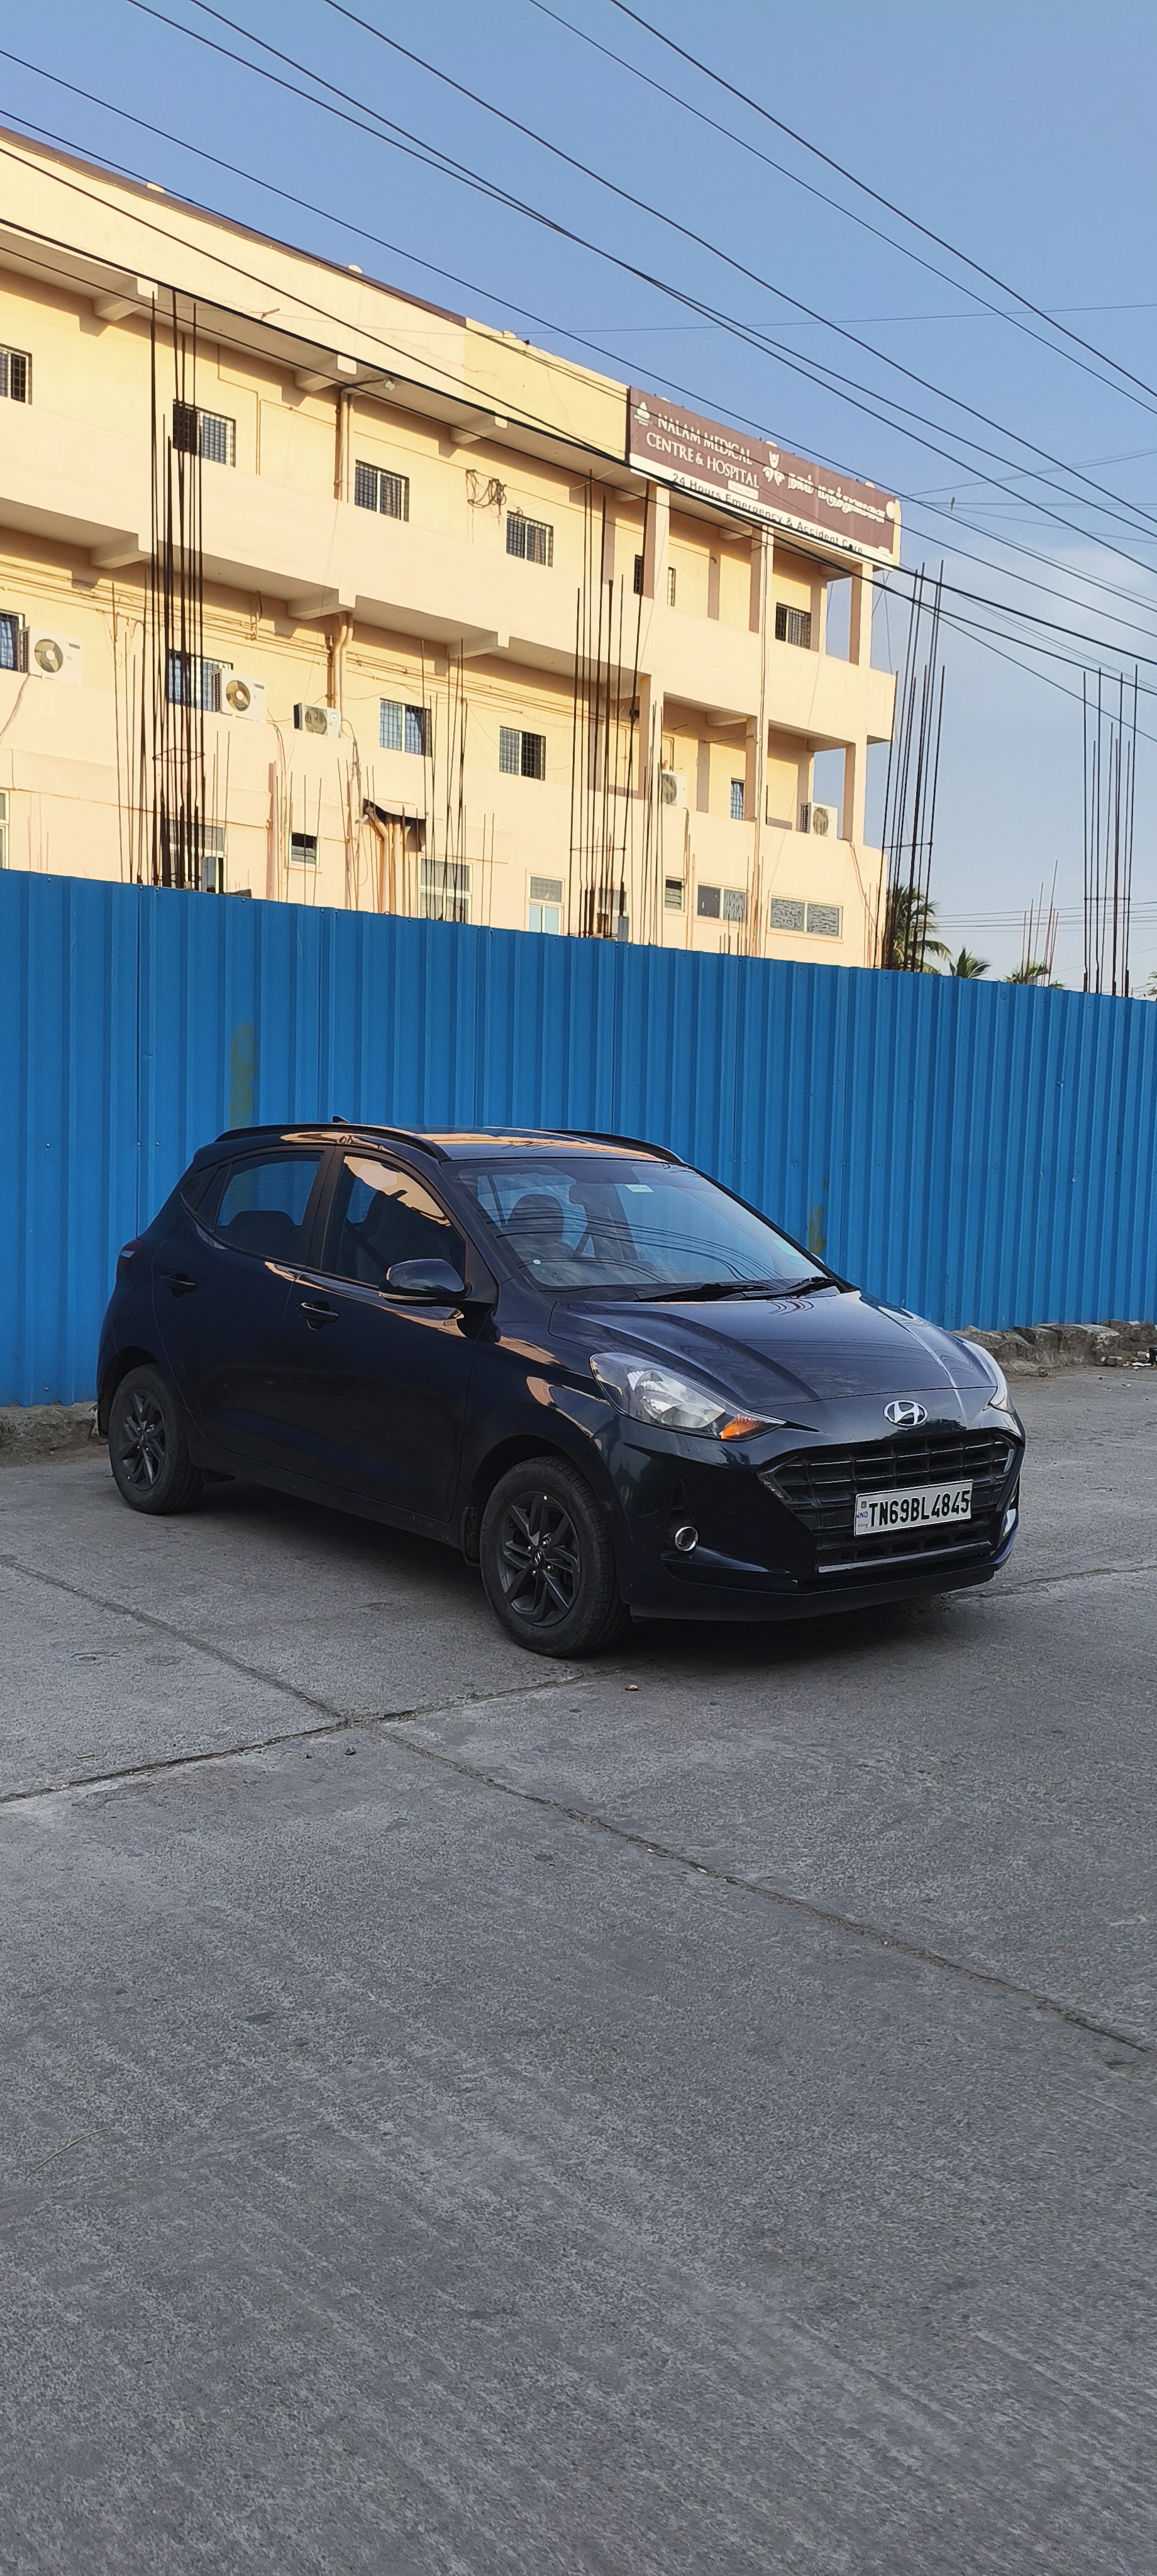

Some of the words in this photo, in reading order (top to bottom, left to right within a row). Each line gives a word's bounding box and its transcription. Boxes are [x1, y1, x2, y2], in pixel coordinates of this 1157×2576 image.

[646, 432, 694, 462] CENTRE
[695, 452, 704, 466] &
[707, 455, 760, 489] HOSPITAL
[658, 413, 701, 444] NALAM
[704, 432, 753, 465] MEDICAL
[673, 473, 686, 486] 24
[690, 480, 721, 499] Hours
[726, 494, 782, 523] Emergency
[787, 517, 793, 528] &
[843, 539, 863, 553] Cre
[869, 1489, 971, 1527] TN69BL4845
